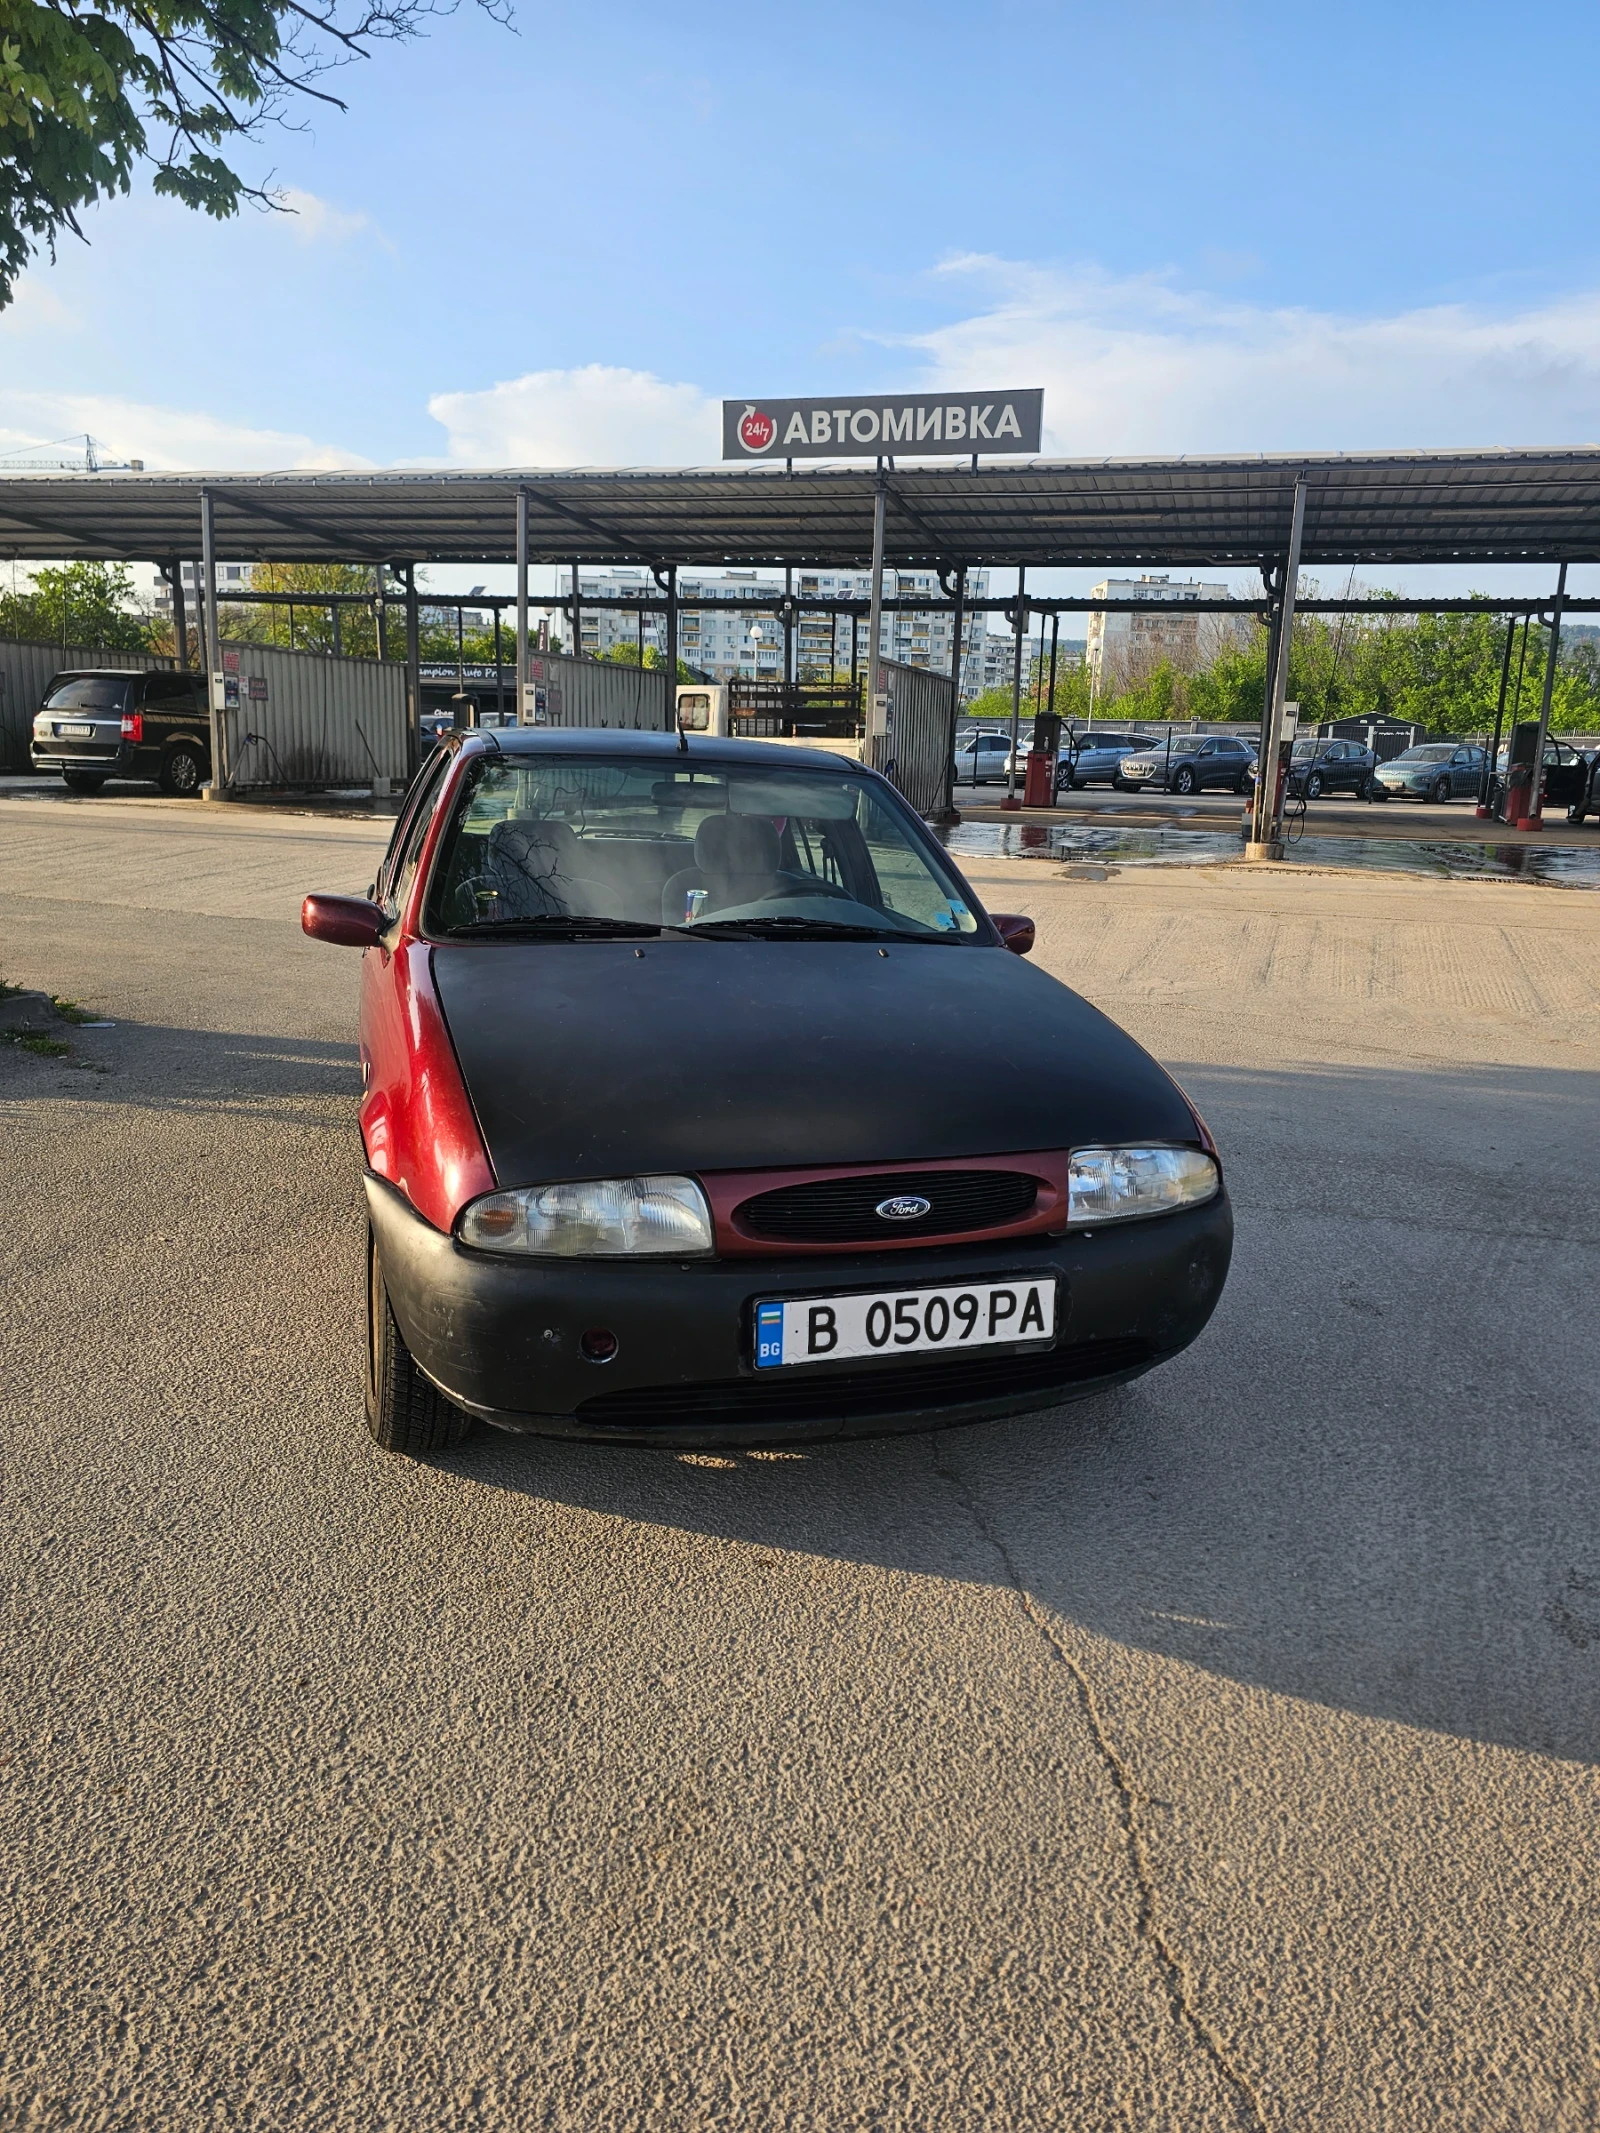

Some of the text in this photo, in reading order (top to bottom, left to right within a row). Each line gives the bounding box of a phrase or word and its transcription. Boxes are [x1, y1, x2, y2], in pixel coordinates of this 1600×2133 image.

[745, 422, 770, 442] 24/7
[783, 404, 1022, 445] АВТОМИВКА
[419, 667, 456, 678] ampion
[458, 667, 482, 678] Auto
[890, 1200, 919, 1215] Ford
[807, 1306, 839, 1355] B
[865, 1293, 979, 1348] 0509
[759, 1341, 781, 1358] BG
